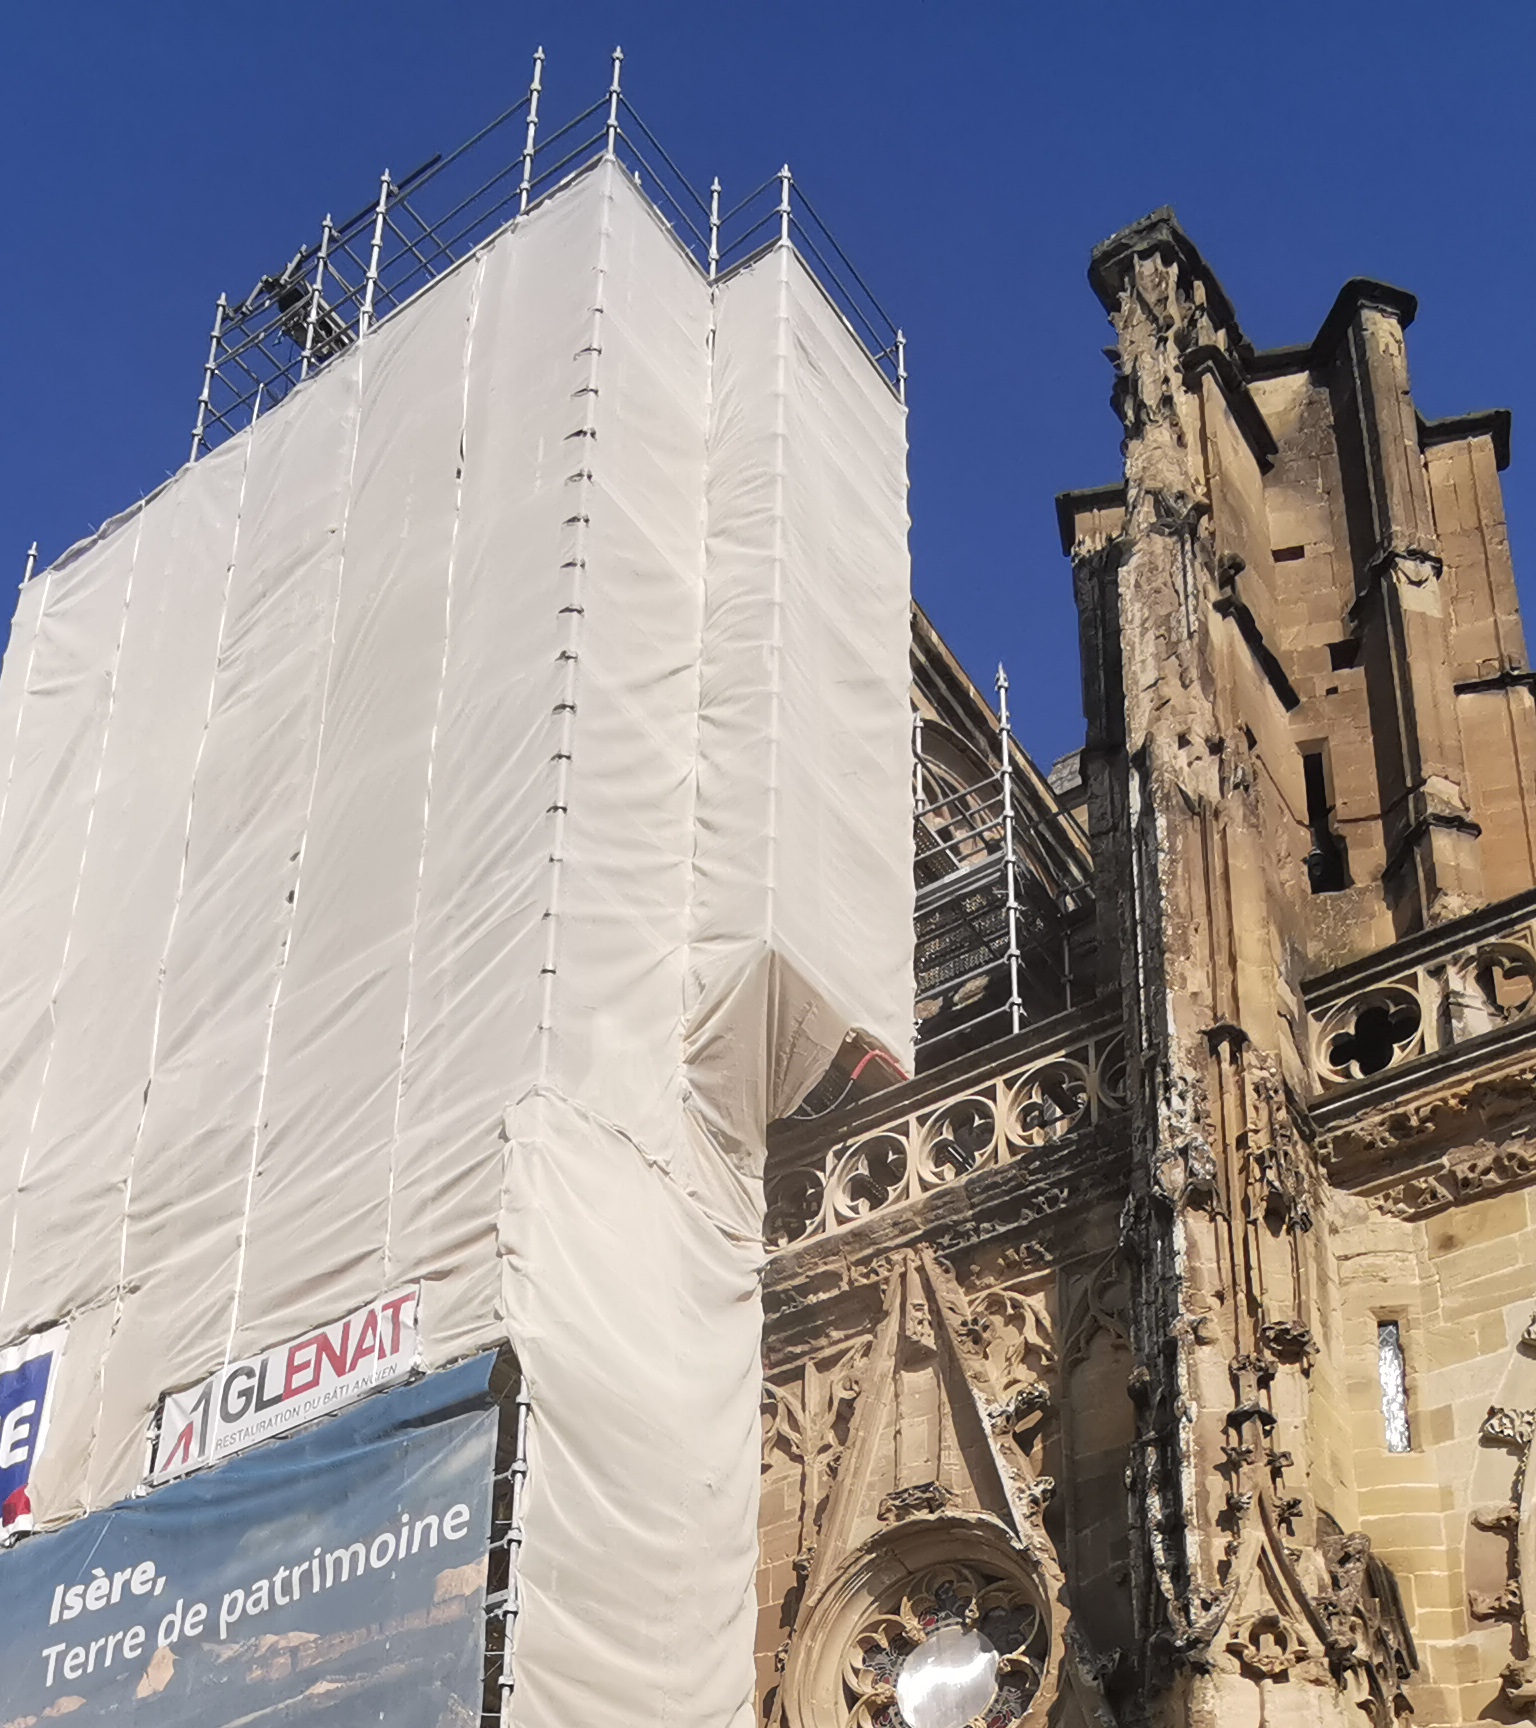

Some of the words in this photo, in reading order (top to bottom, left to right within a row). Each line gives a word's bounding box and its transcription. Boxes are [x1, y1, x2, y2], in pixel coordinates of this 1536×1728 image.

[216, 1406, 300, 1450] RESTAURATION
[304, 1396, 321, 1414] DU
[353, 1363, 398, 1392] ANCIEN
[220, 1290, 416, 1423] GLENAT
[42, 1625, 145, 1687] Terre
[158, 1599, 208, 1647] de
[219, 1503, 470, 1640] patrimoine
[48, 1559, 166, 1626] Isère,
